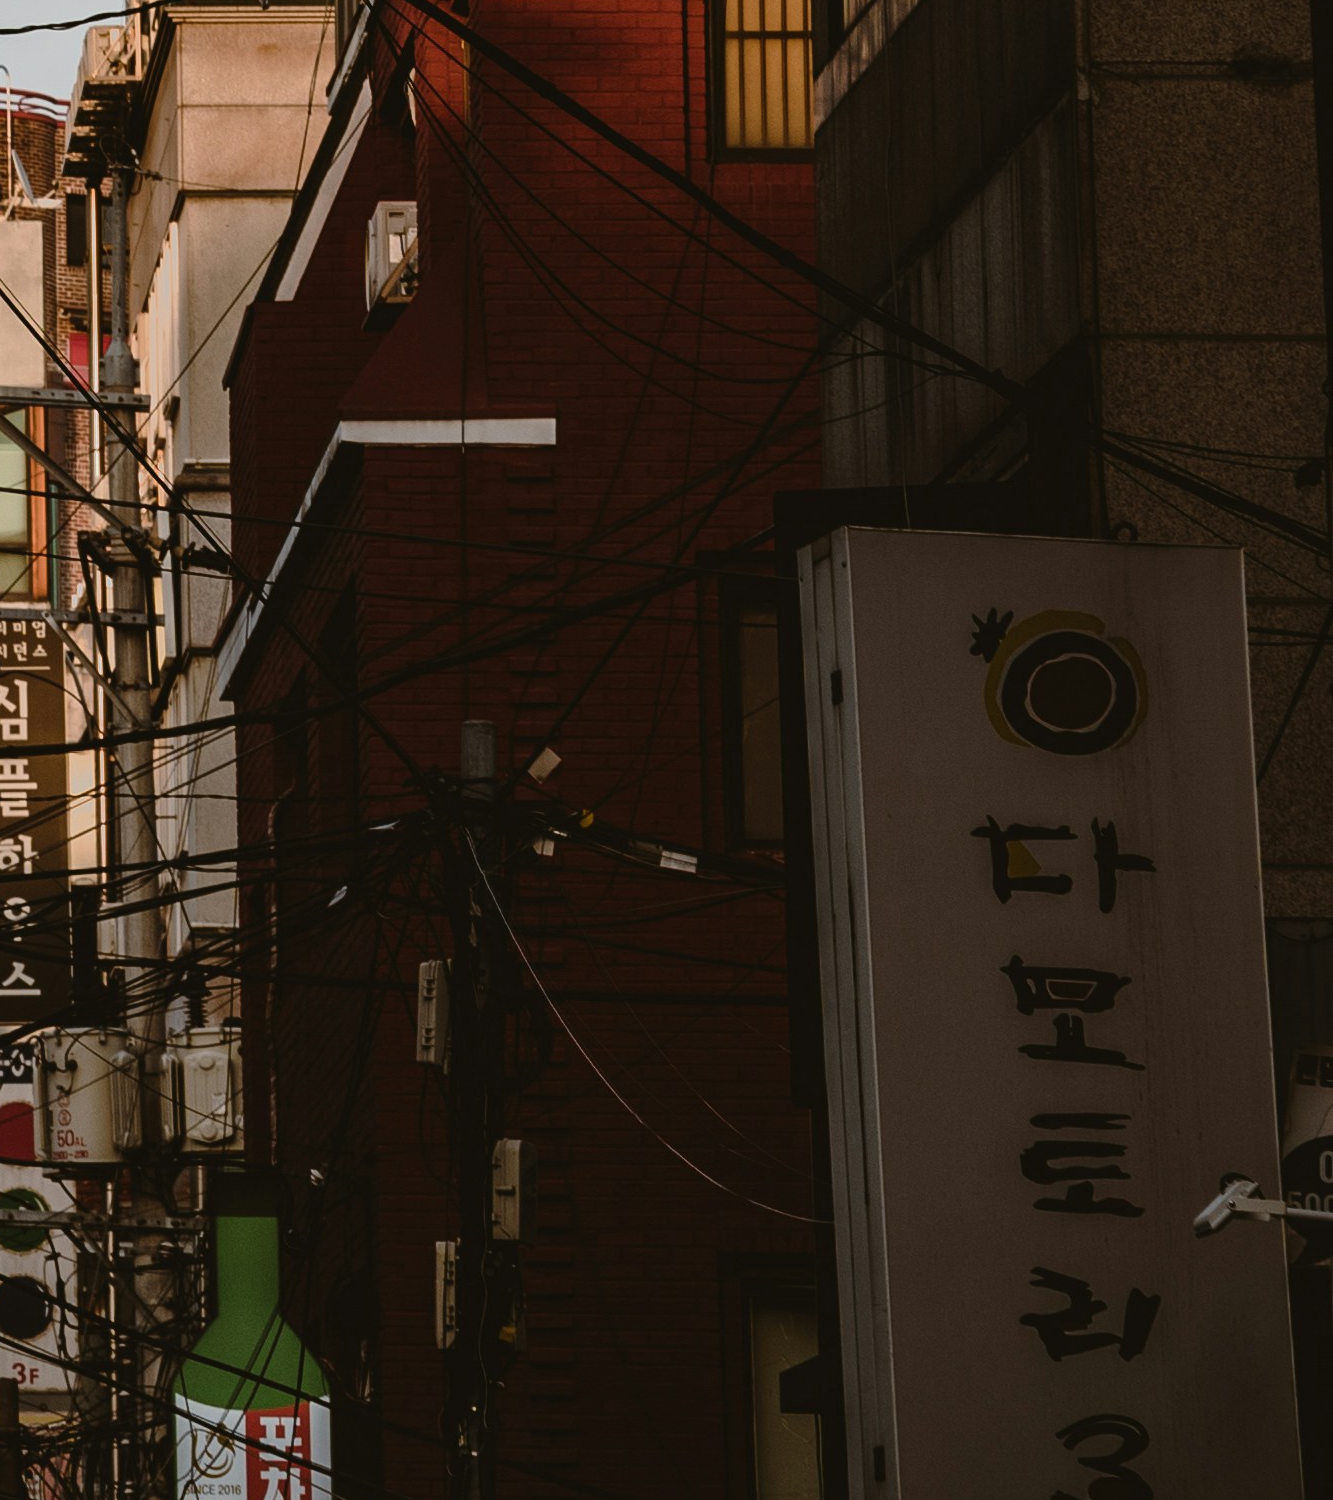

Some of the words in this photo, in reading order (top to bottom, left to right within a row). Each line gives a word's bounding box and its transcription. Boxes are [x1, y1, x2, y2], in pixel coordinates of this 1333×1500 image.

[12, 1362, 40, 1386] 3F
[182, 1483, 216, 1497] SINCE
[217, 1483, 242, 1496] 2016
